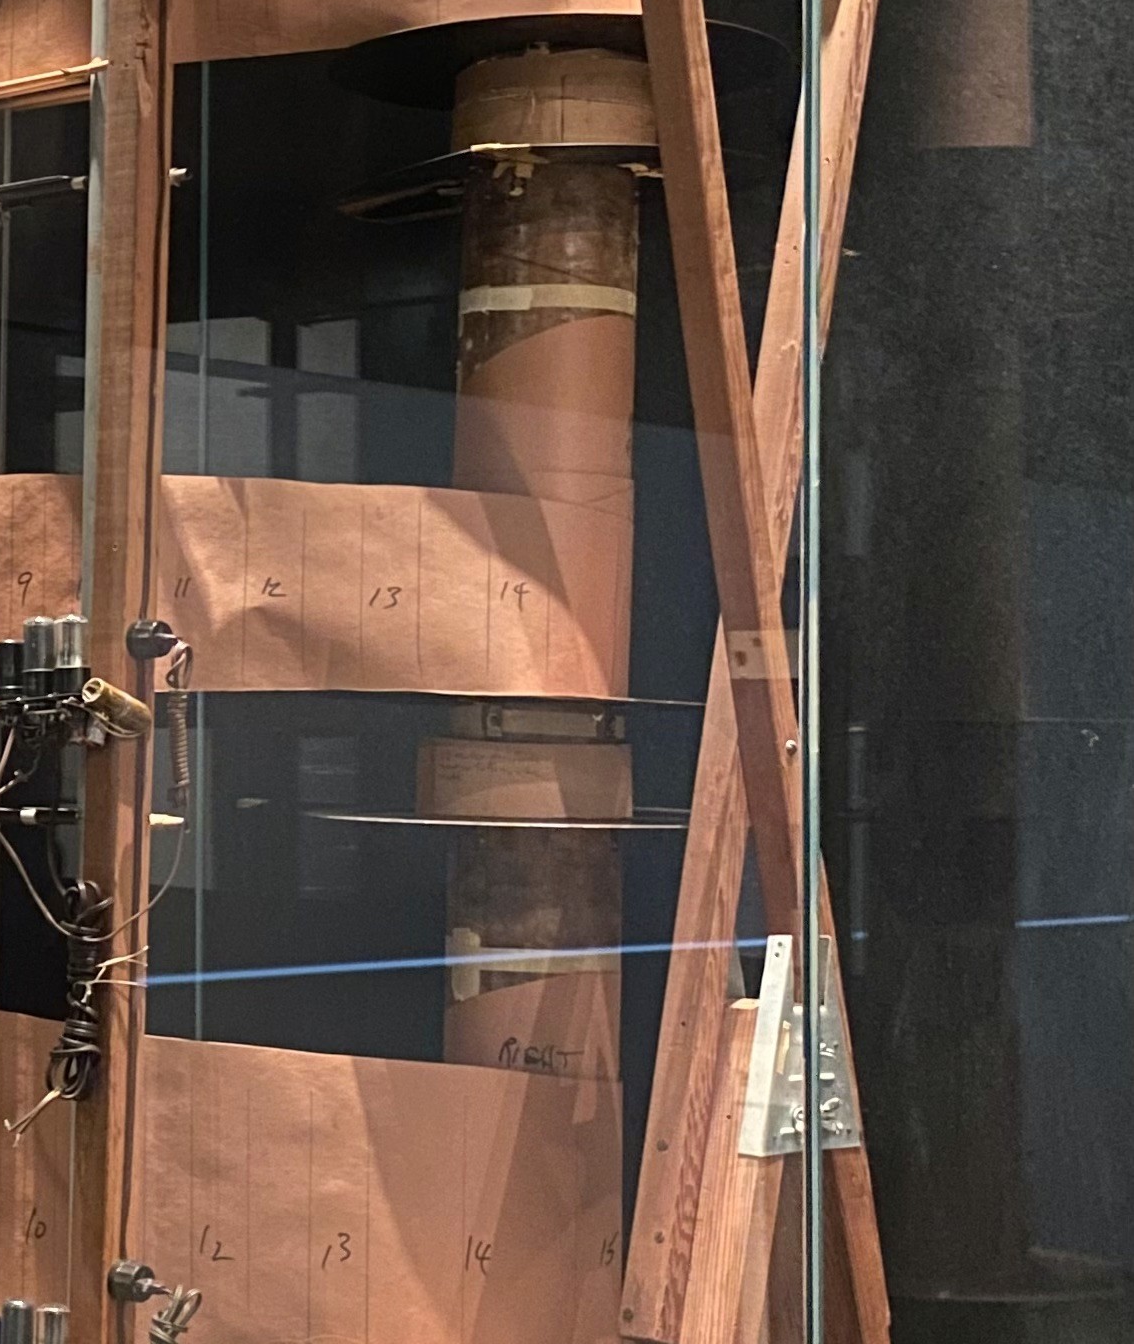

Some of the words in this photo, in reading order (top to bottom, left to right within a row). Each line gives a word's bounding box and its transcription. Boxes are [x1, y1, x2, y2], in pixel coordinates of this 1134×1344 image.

[17, 571, 33, 607] 9
[174, 577, 191, 598] 11
[368, 586, 403, 609] 13
[500, 581, 530, 612] 14
[25, 1207, 47, 1245] 10
[199, 1224, 236, 1262] 12
[321, 1232, 352, 1270] 13
[465, 1235, 492, 1276] 14
[600, 1231, 619, 1267] 15
